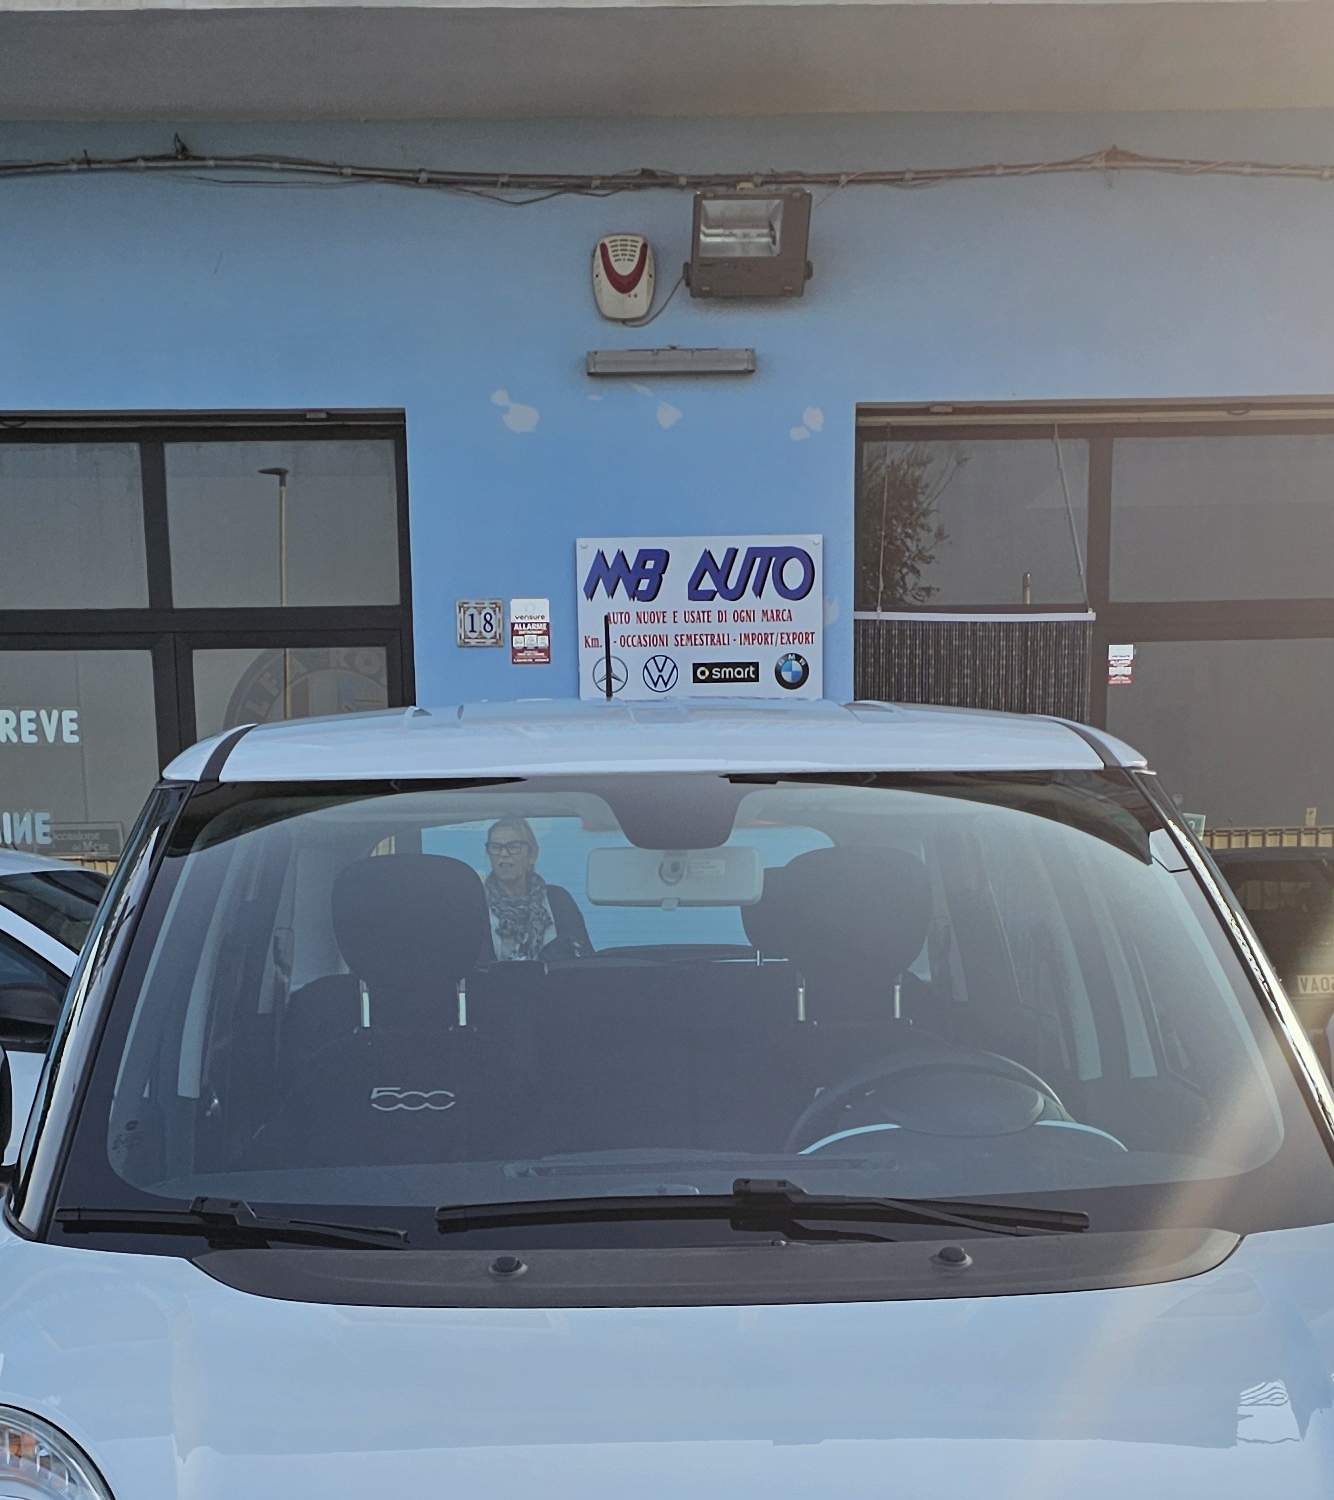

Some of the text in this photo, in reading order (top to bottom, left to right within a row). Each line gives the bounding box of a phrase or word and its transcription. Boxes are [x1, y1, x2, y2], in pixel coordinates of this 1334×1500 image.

[583, 546, 816, 602] MB AUTO
[468, 612, 494, 634] 18
[606, 609, 793, 625] AUTO NUOVE E USATE DI OGNI MARCA
[583, 635, 603, 648] Km.
[619, 634, 669, 648] OCCASIONI
[674, 633, 730, 647] SEMESTRALI
[739, 631, 816, 647] IMPORT/EXPORT
[711, 665, 756, 679] smart
[370, 1086, 456, 1111] 500
